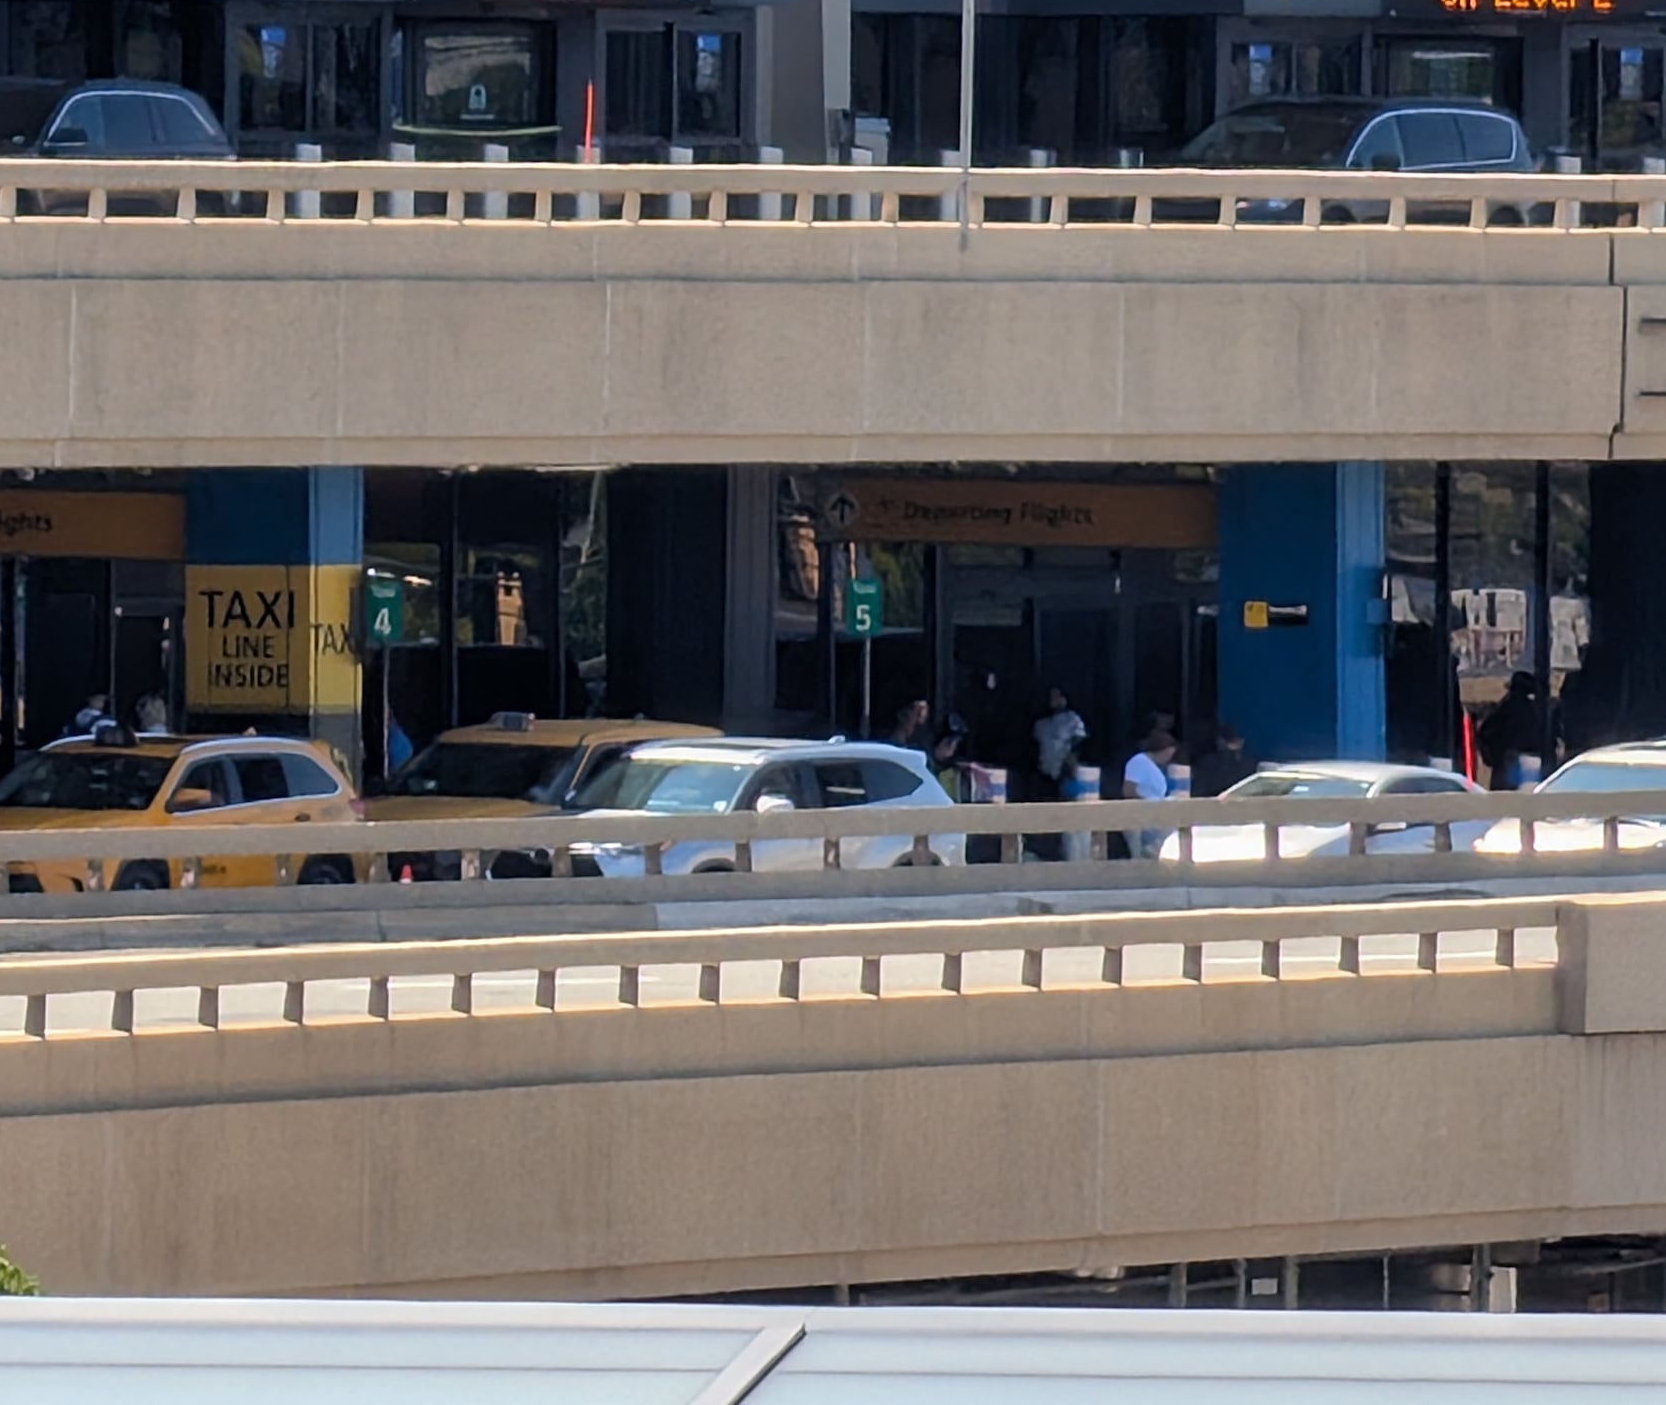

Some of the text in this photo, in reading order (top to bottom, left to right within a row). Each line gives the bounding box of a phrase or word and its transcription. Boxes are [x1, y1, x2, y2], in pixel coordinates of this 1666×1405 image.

[198, 590, 295, 629] TAXI
[373, 607, 392, 635] 4
[855, 604, 871, 632] 5
[221, 635, 276, 658] LINE
[310, 623, 352, 655] TAX
[208, 663, 290, 687] INSIDE
